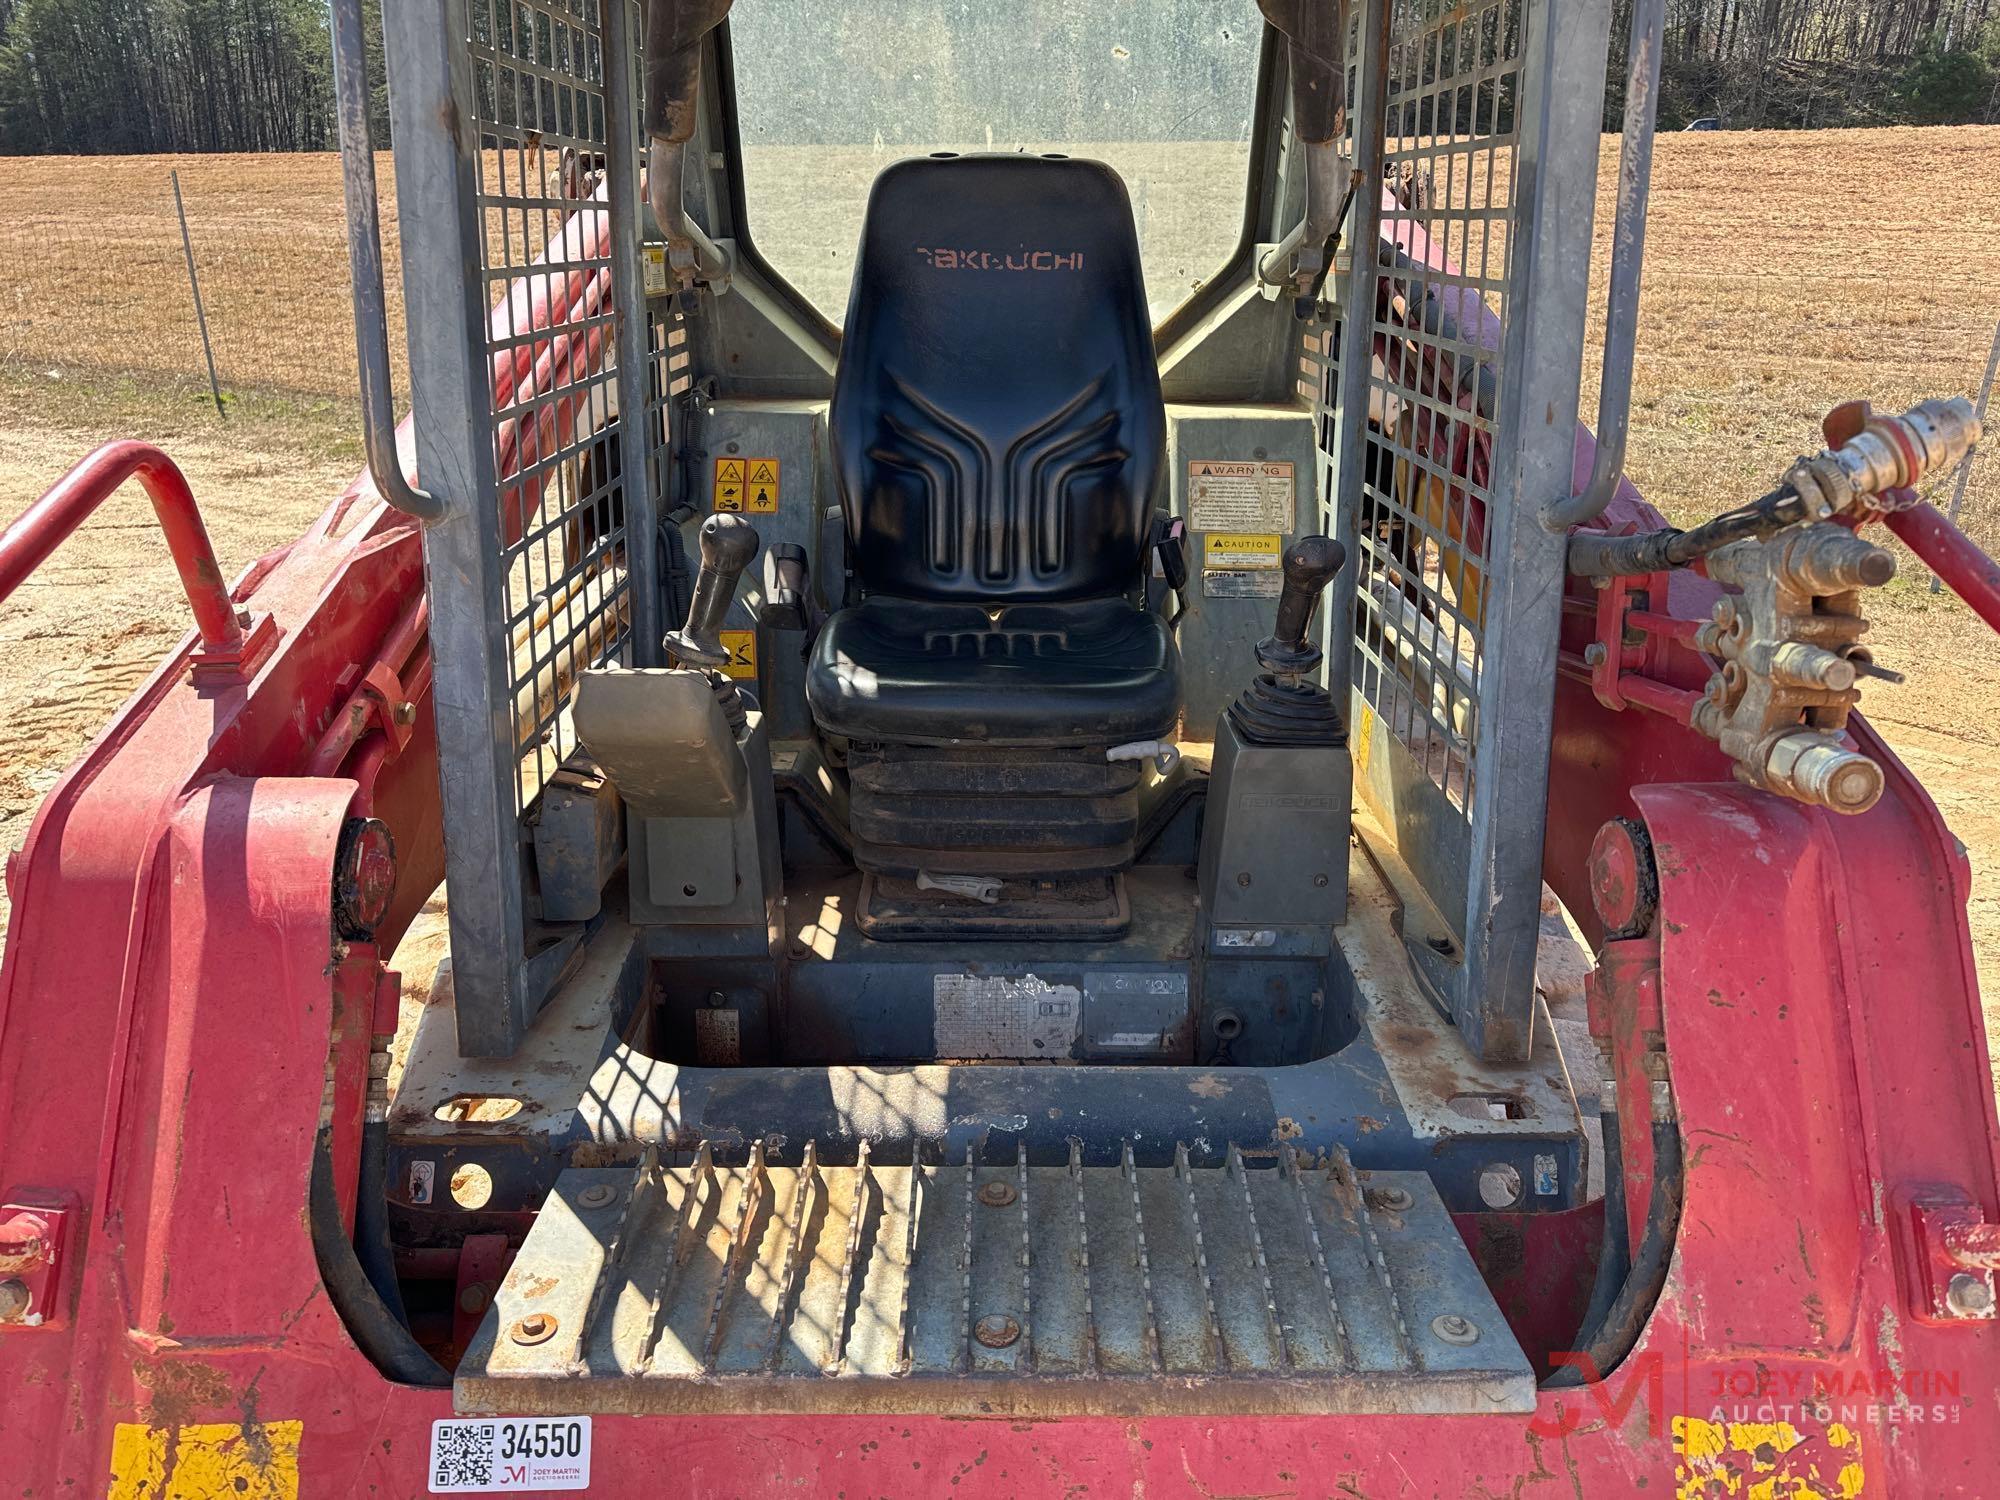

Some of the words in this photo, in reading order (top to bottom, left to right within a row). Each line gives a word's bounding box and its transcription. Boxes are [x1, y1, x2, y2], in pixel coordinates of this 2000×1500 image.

[1214, 467, 1280, 475] WARNNG
[1223, 540, 1271, 548] CAUTION
[502, 1423, 581, 1459] 34550
